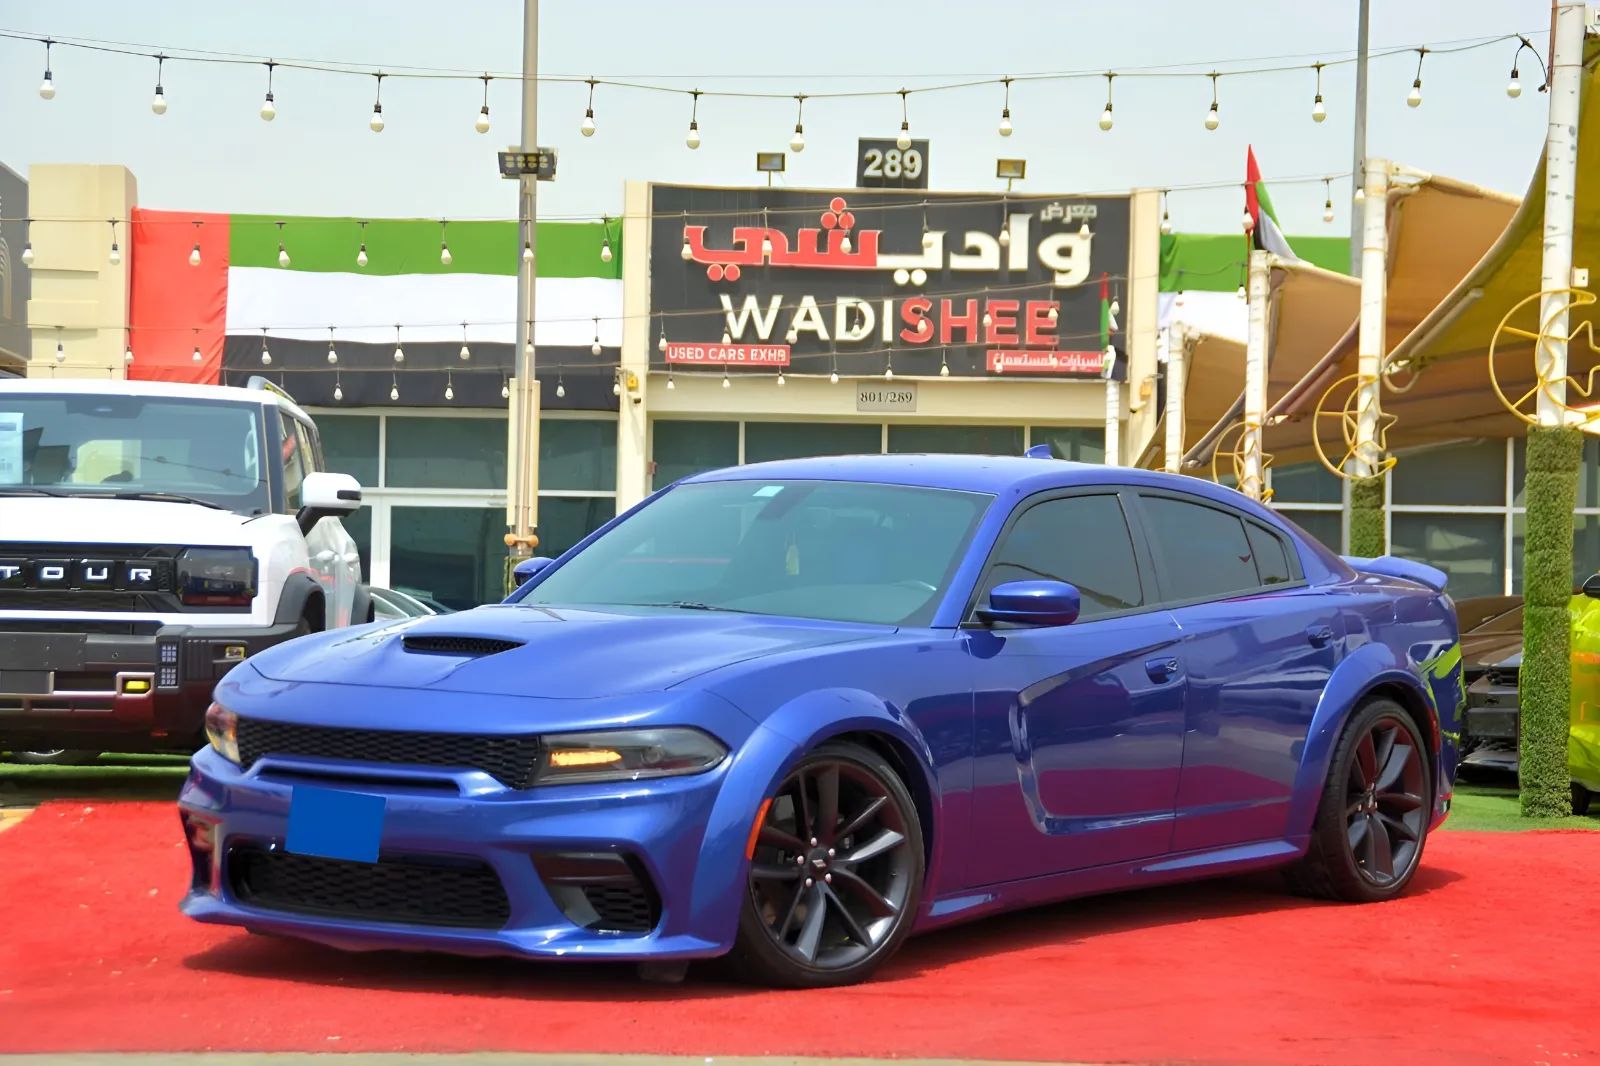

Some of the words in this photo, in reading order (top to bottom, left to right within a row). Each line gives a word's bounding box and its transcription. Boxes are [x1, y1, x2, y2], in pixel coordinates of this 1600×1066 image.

[863, 148, 922, 179] 289
[1040, 201, 1098, 224] معرض
[668, 346, 705, 360] USED
[708, 347, 746, 361] CARS
[992, 352, 1059, 369] لمستعملة
[860, 391, 913, 403] 801/289
